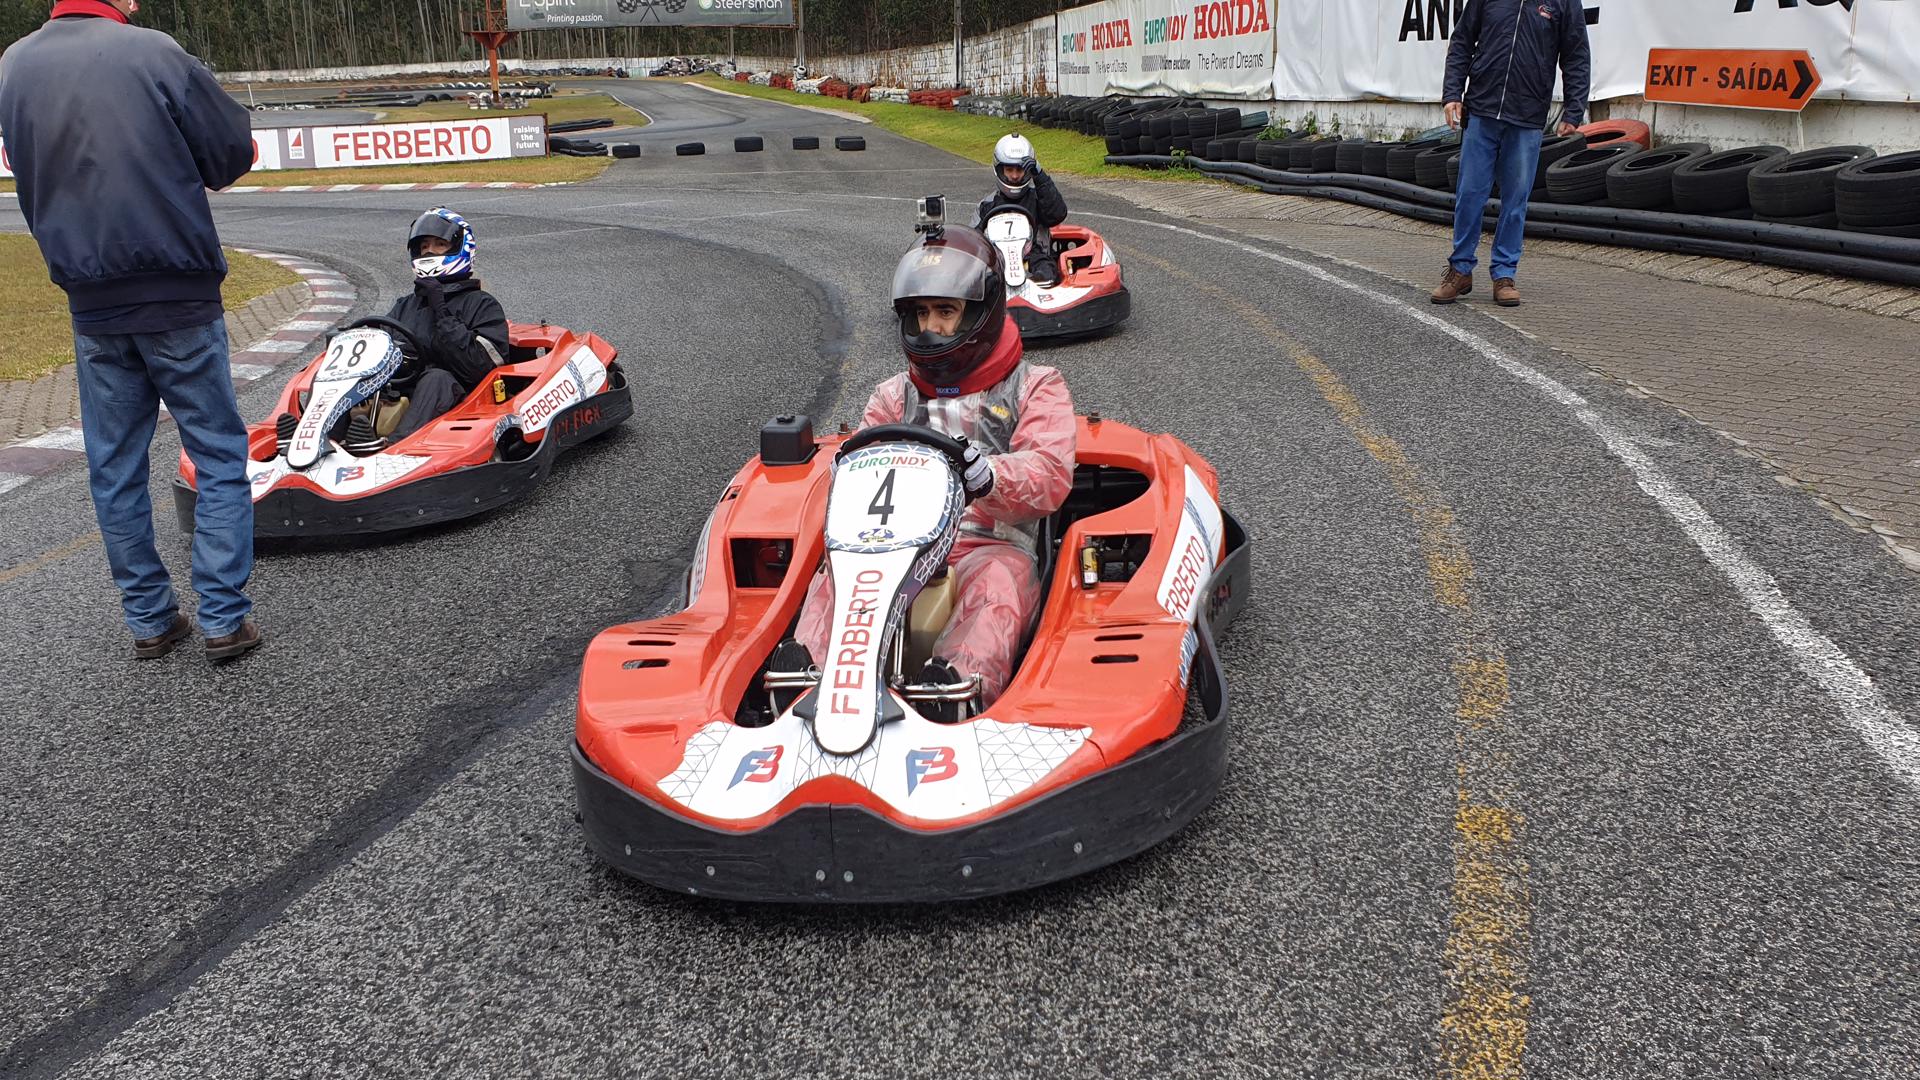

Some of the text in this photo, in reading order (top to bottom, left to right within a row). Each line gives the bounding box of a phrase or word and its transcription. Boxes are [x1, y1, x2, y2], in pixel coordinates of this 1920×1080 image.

[547, 14, 574, 24] Printing
[1194, 0, 1269, 40] HONDA
[1198, 53, 1210, 70] The
[1236, 52, 1264, 69] Dreams
[1649, 65, 1697, 87] EXIT
[1717, 62, 1788, 92] SAÍDA
[513, 125, 540, 134] raising
[520, 133, 534, 141] the
[332, 124, 492, 162] FERBERTO
[515, 140, 540, 149] future
[1004, 220, 1014, 236] 7
[324, 339, 368, 372] 28
[848, 455, 930, 473] EUROINDY
[867, 468, 896, 525] 4
[830, 569, 884, 715] FERBERTO
